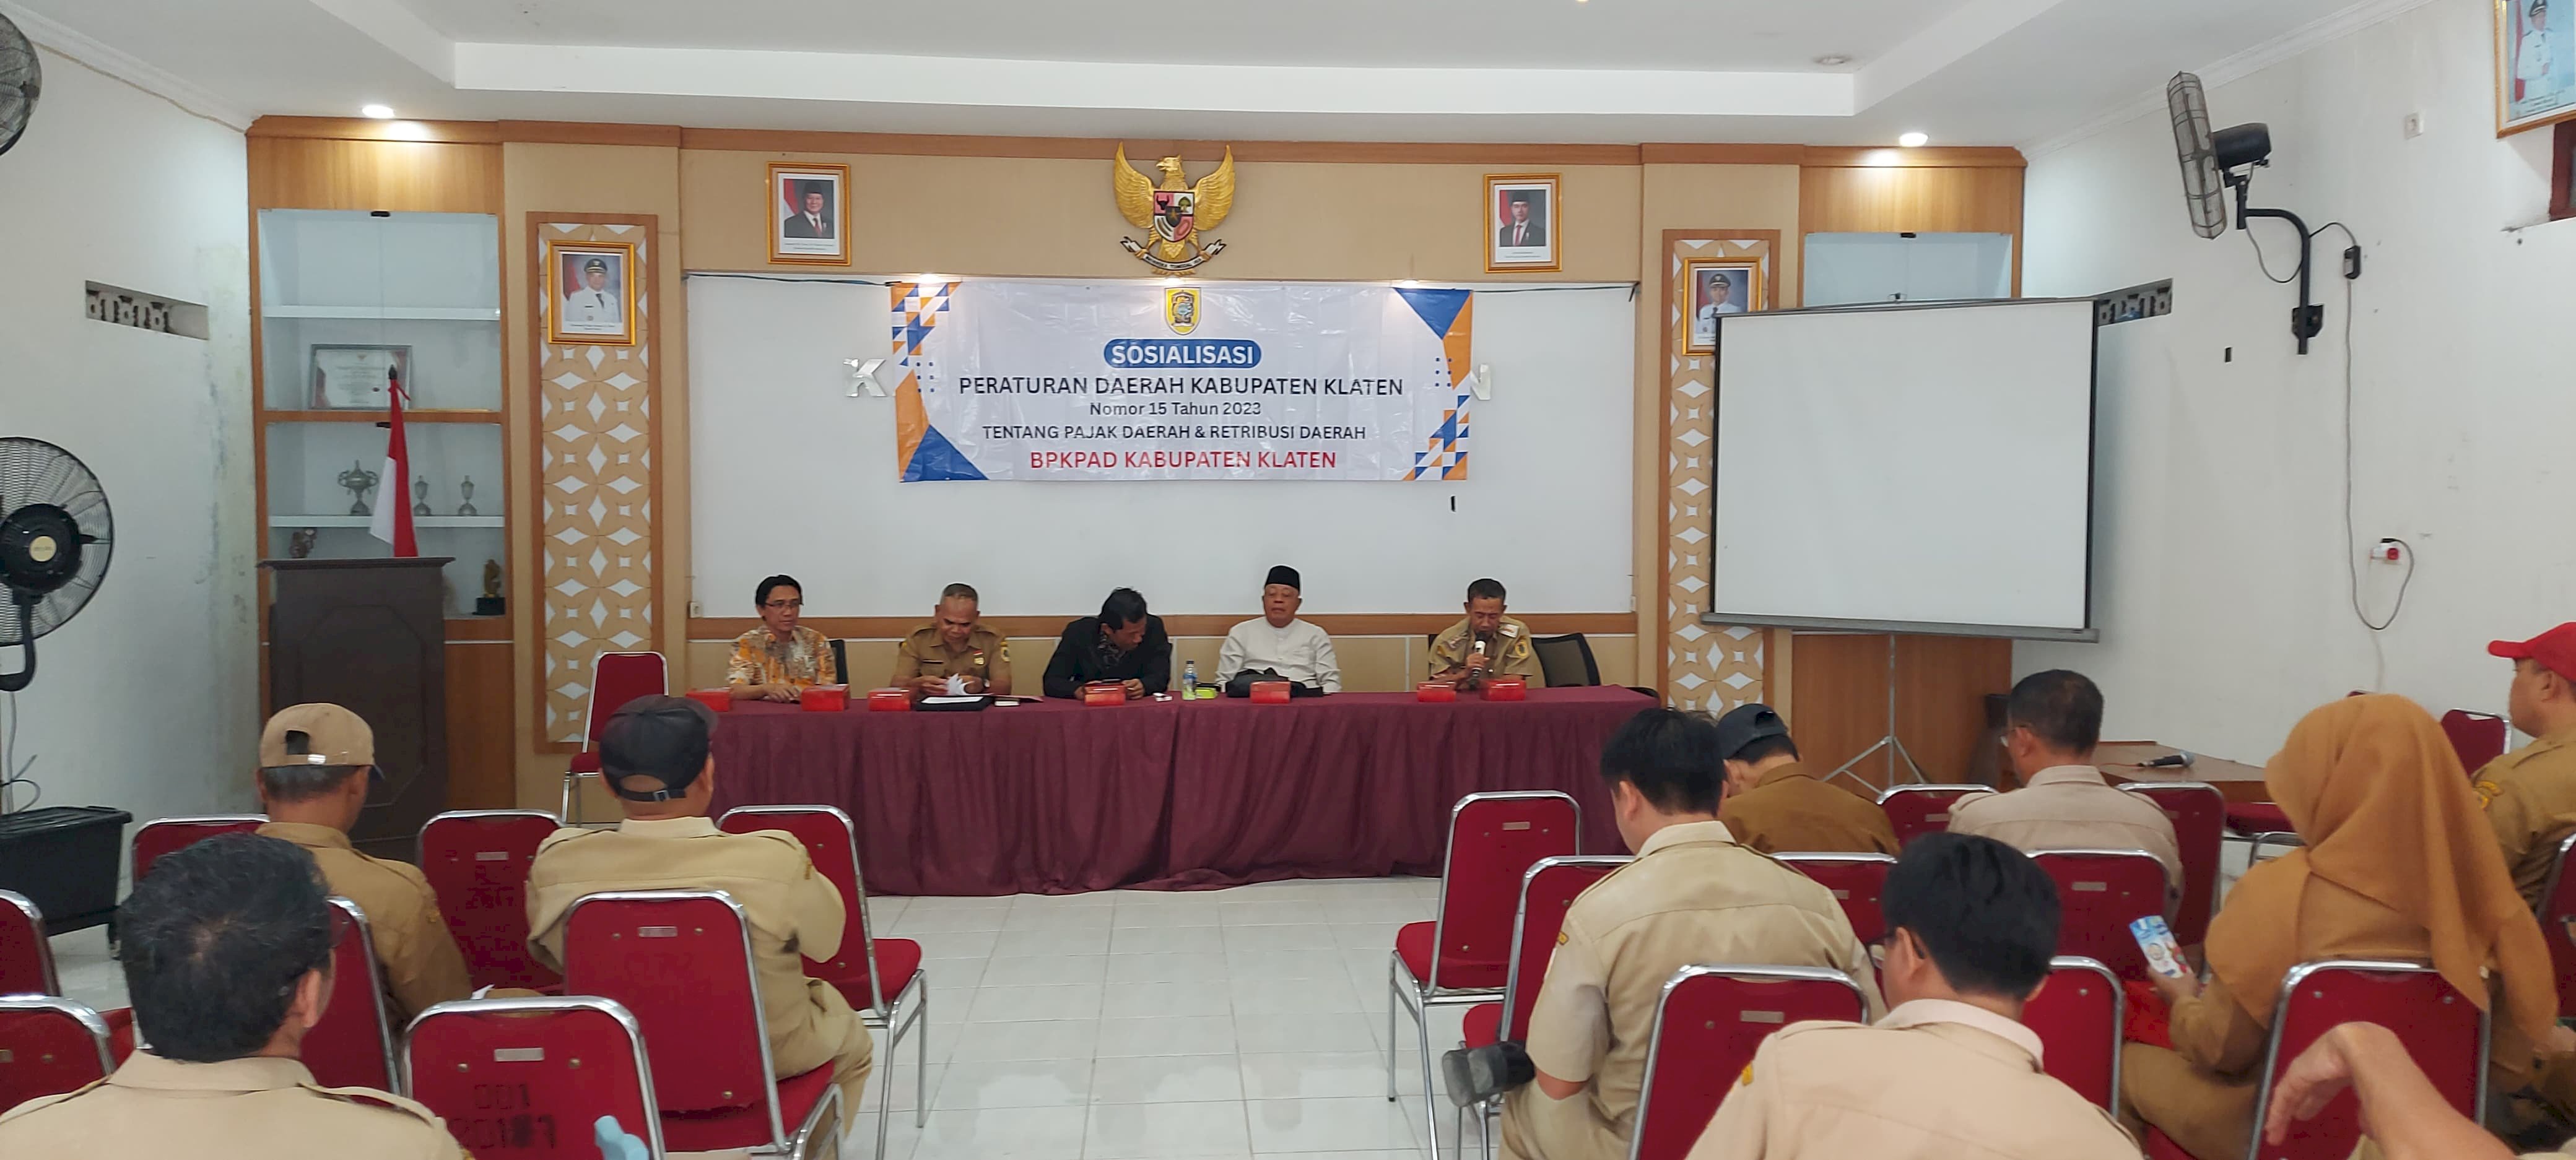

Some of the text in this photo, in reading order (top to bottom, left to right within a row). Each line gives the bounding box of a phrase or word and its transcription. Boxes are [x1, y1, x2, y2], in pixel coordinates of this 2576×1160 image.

[1112, 345, 1253, 365] SOSIALISASI
[959, 377, 1403, 396] PERATURAN DAERAH KABUPATEN KLATEN
[1090, 402, 1261, 415] Nomor 15 Tahun 2023
[983, 426, 1366, 439] TENTANG PAJAK DAERAH & RETRIBUSI DAERAH
[1030, 451, 1336, 469] BPKPAD KABUPATEN KLATEN
